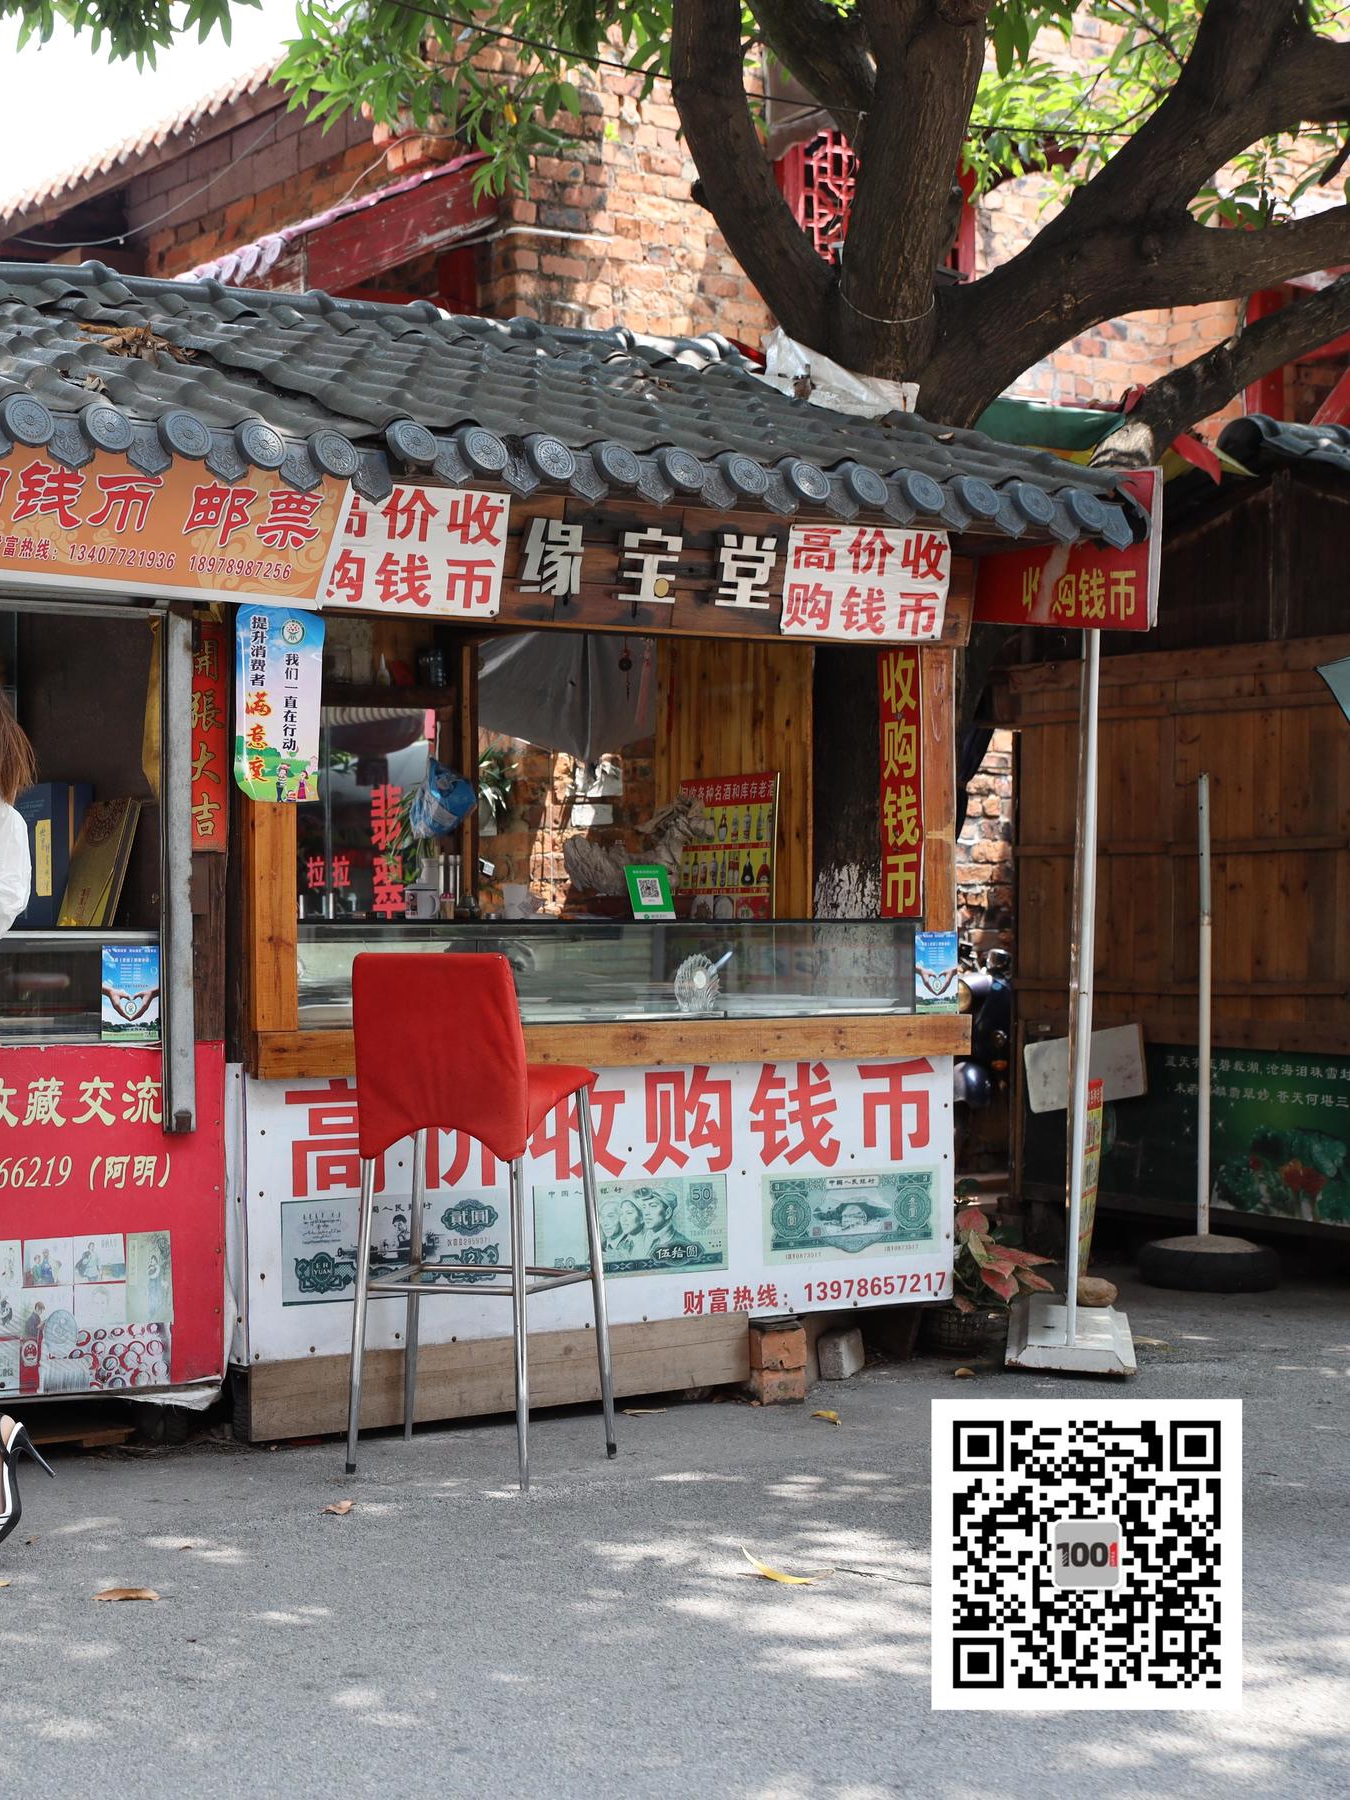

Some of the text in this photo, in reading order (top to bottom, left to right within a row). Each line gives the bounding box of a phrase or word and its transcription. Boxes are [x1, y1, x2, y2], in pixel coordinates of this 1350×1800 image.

[183, 481, 326, 550] 邮票
[68, 543, 177, 570] 13407721936
[188, 555, 294, 581] 18978987256
[518, 517, 777, 609] 缘宝堂
[793, 528, 948, 581] 高价收
[783, 582, 940, 637] 购钱币
[282, 653, 300, 752] 我们一直在行动
[882, 652, 920, 914] 收购钱币
[692, 1188, 711, 1201] 50
[804, 1271, 946, 1303] 13978657217
